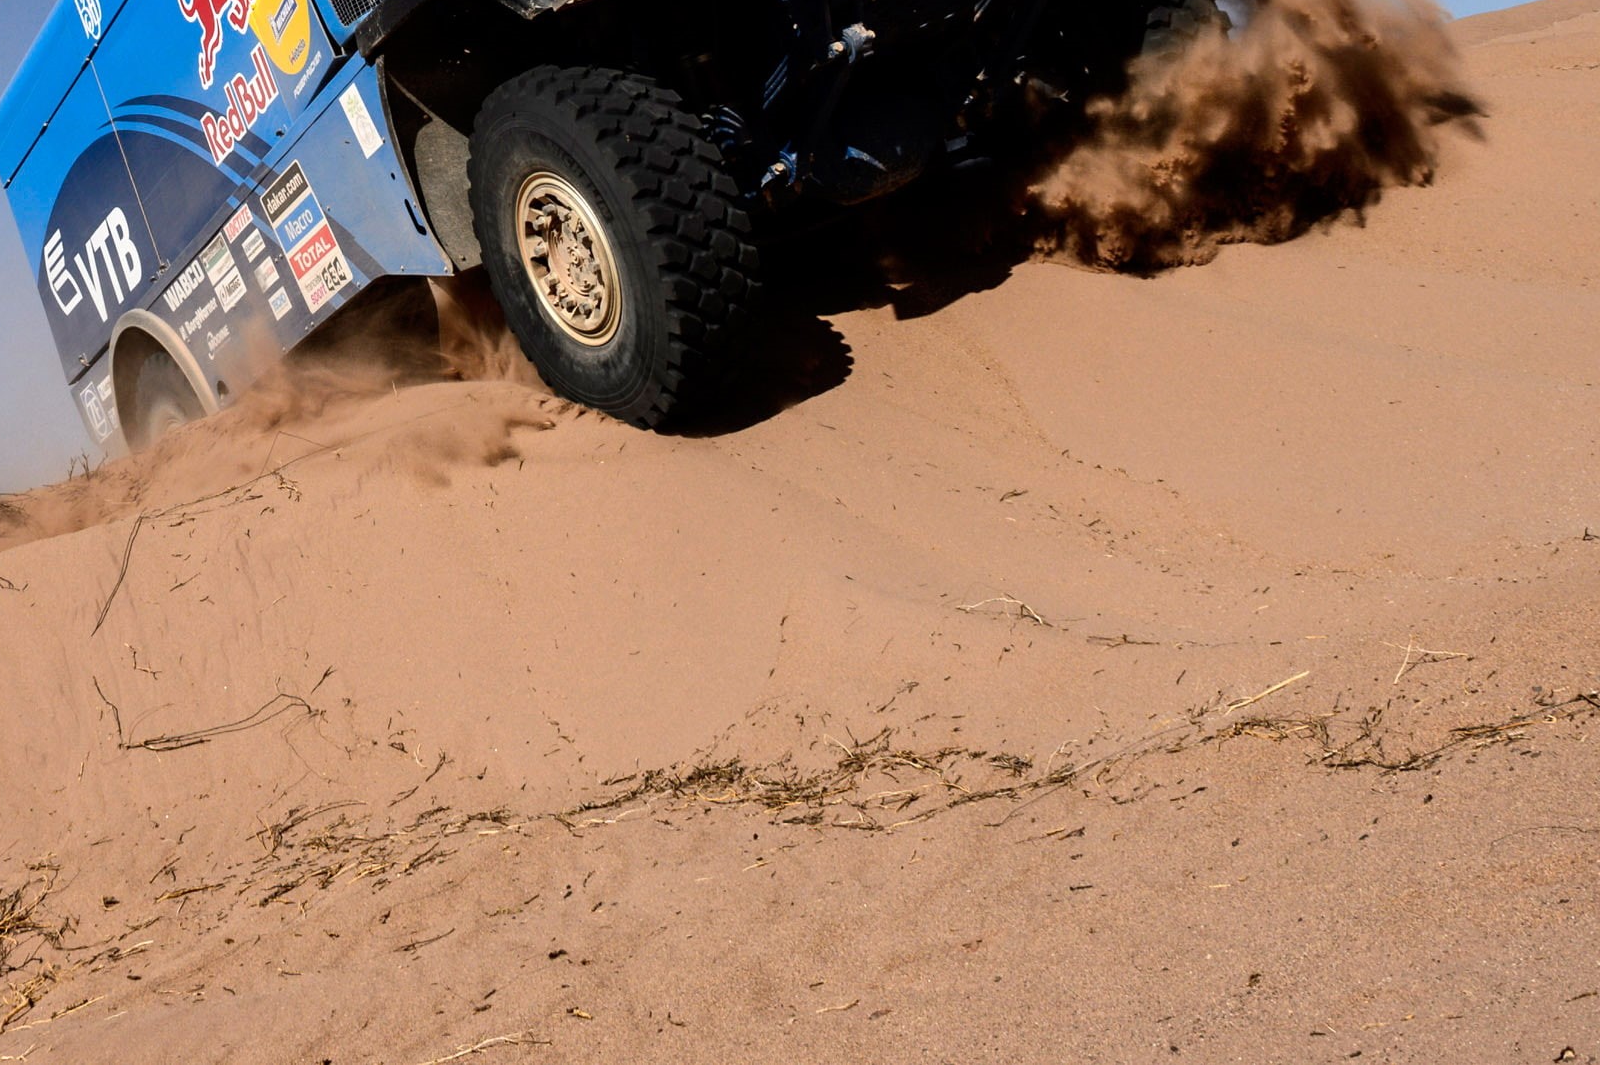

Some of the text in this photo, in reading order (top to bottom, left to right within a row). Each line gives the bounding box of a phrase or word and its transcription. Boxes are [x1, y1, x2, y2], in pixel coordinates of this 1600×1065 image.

[201, 44, 278, 164] Red Bull
[266, 172, 304, 215] dakar.com
[225, 205, 253, 240] LOCTITE
[284, 209, 314, 243] Macro
[74, 206, 142, 323] VTB
[294, 237, 331, 272] TOTAL
[163, 259, 206, 313] WABCO
